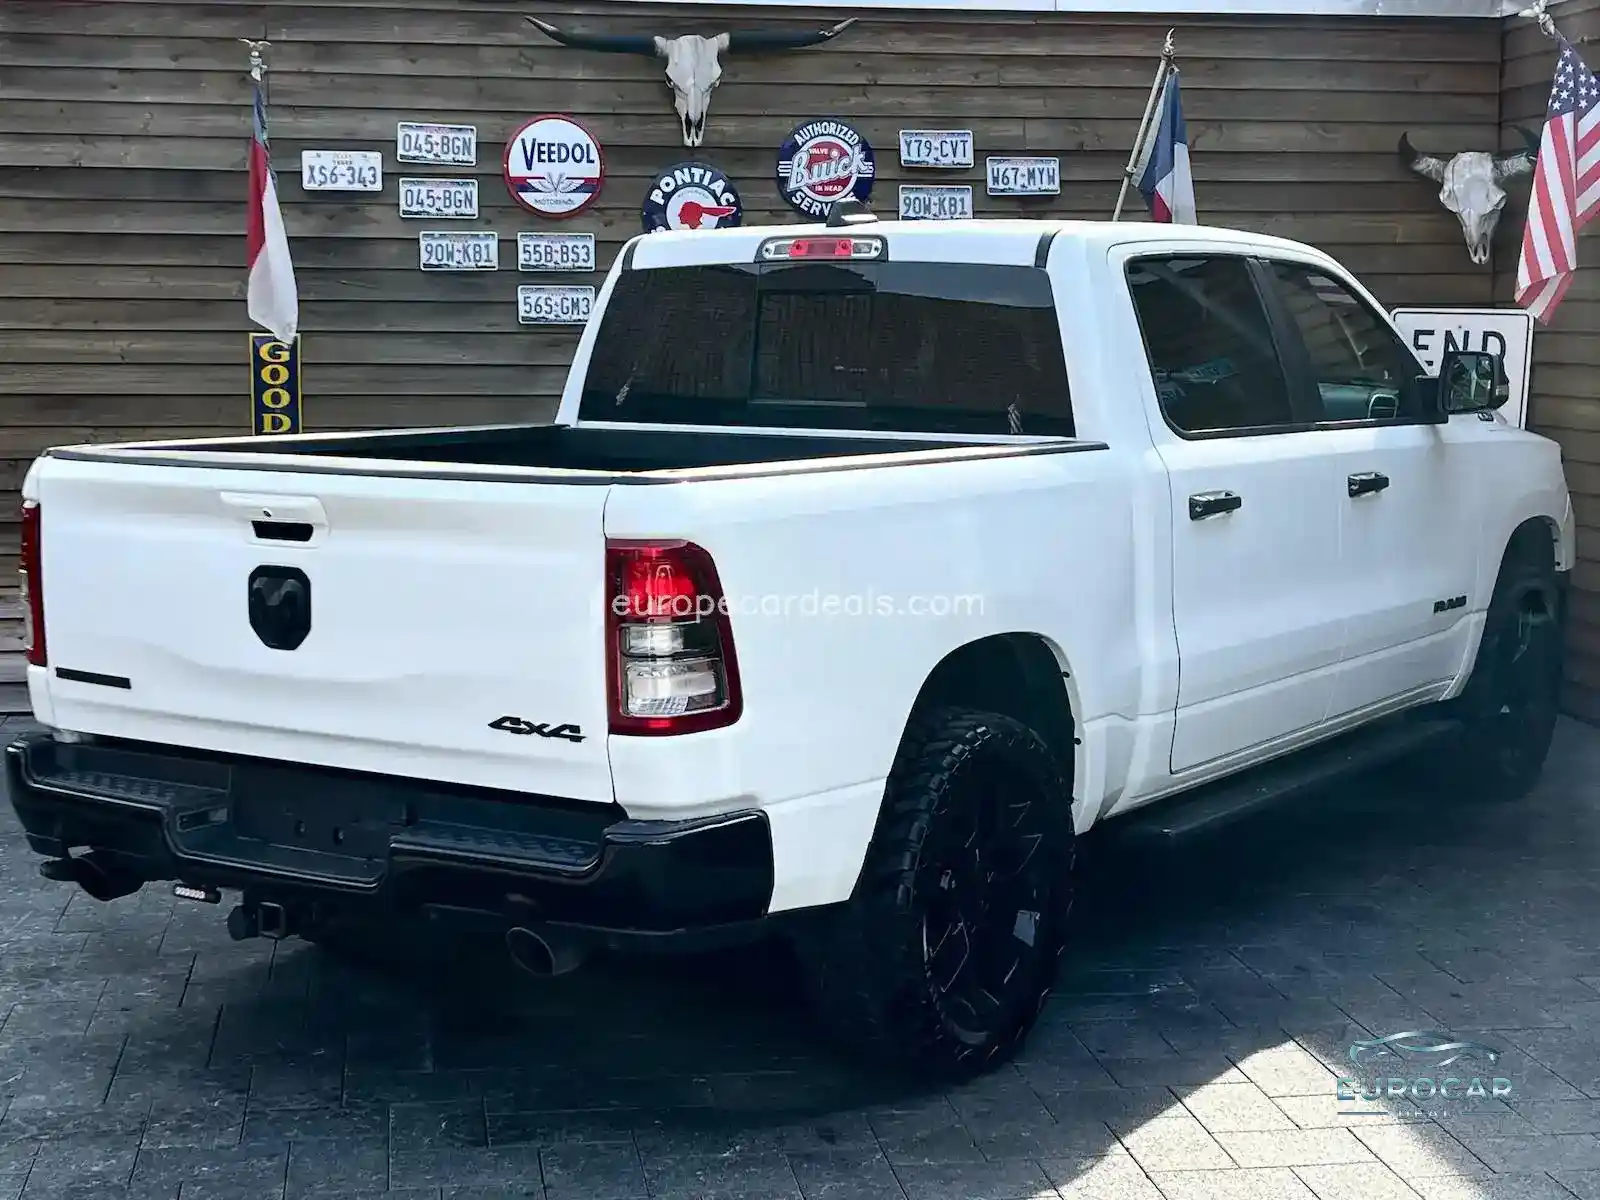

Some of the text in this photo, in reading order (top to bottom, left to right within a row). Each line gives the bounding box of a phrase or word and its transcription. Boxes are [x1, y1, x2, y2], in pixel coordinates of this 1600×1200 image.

[793, 121, 860, 146] AUTHORIZED
[520, 137, 595, 171] VEEDOL
[786, 143, 867, 193] Buick
[649, 167, 736, 206] PONTIAC
[258, 341, 292, 433] GOOD
